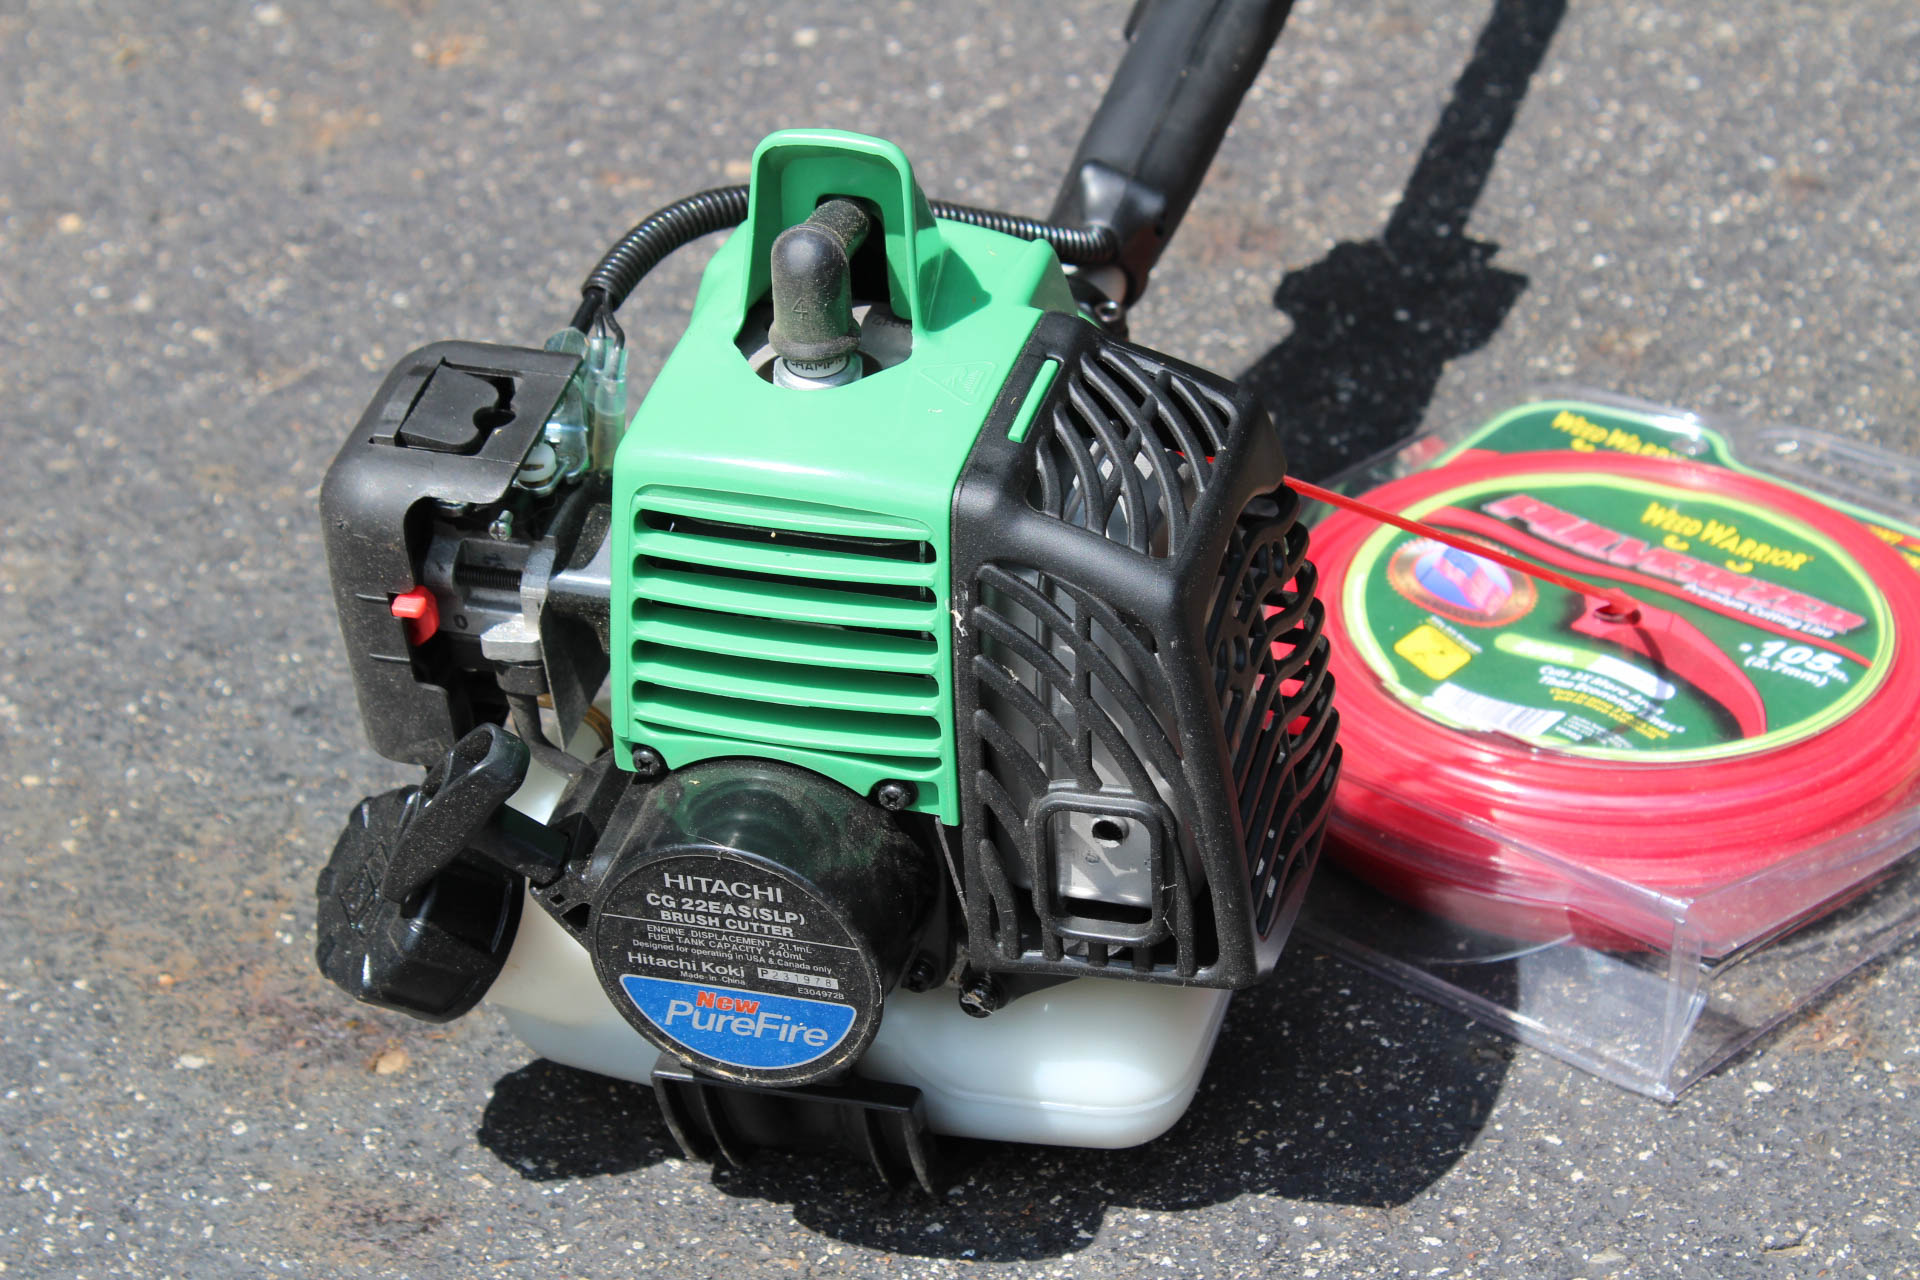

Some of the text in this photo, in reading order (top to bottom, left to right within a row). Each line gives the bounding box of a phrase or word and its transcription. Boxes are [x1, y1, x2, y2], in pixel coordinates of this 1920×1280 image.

[1700, 519, 1808, 571] WARRIOR
[1748, 603, 1802, 630] Cutting
[663, 872, 783, 903] HITACHI
[646, 893, 805, 926] CG 22EAS(SLP)
[660, 910, 793, 938] BRUSH CUTTER
[647, 924, 812, 955] ENGINE DISPLACEMENT 21.1mL
[648, 933, 805, 961] FUEL TANK CAPACITY 440mL
[628, 952, 745, 978] Hitachi Koki
[633, 939, 833, 975] Designed for operating in USA & Canada only
[680, 970, 746, 986] Made in China
[696, 991, 760, 1015] New
[665, 999, 829, 1048] PureFire
